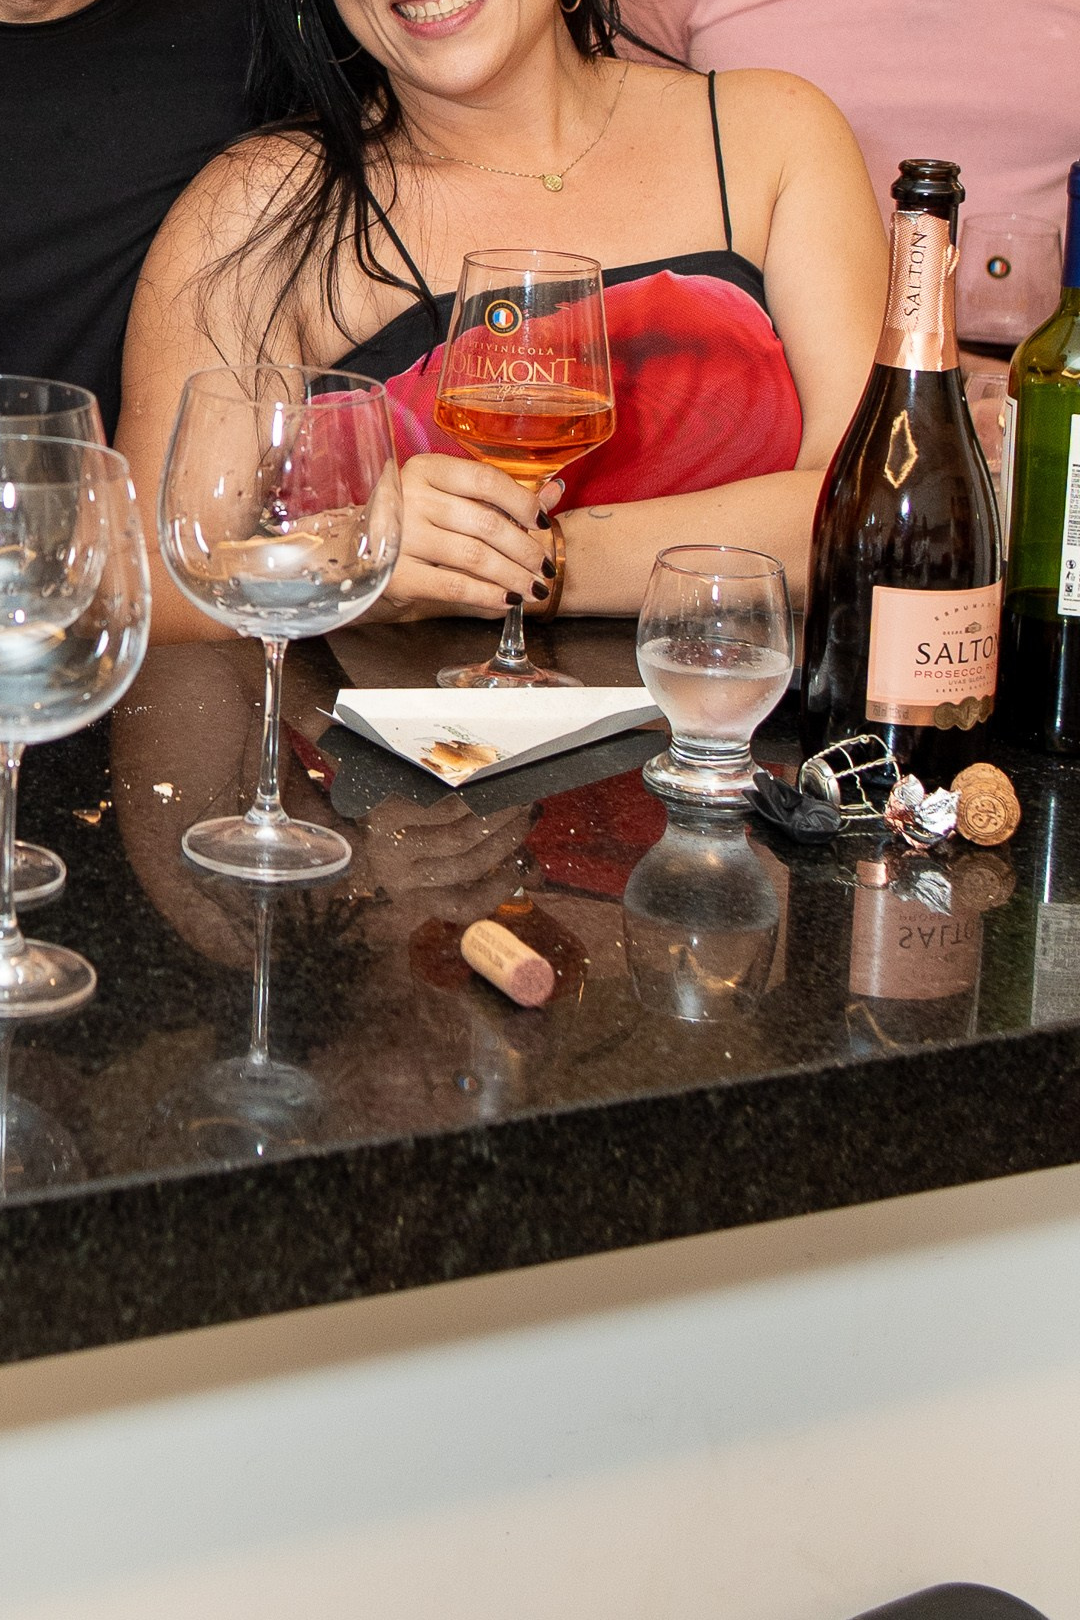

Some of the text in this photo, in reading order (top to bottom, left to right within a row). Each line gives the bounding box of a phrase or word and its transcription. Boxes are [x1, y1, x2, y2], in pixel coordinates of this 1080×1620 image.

[904, 231, 928, 317] SALTON
[469, 341, 555, 356] TIVINÍCOLA
[914, 666, 983, 679] PROSECCO
